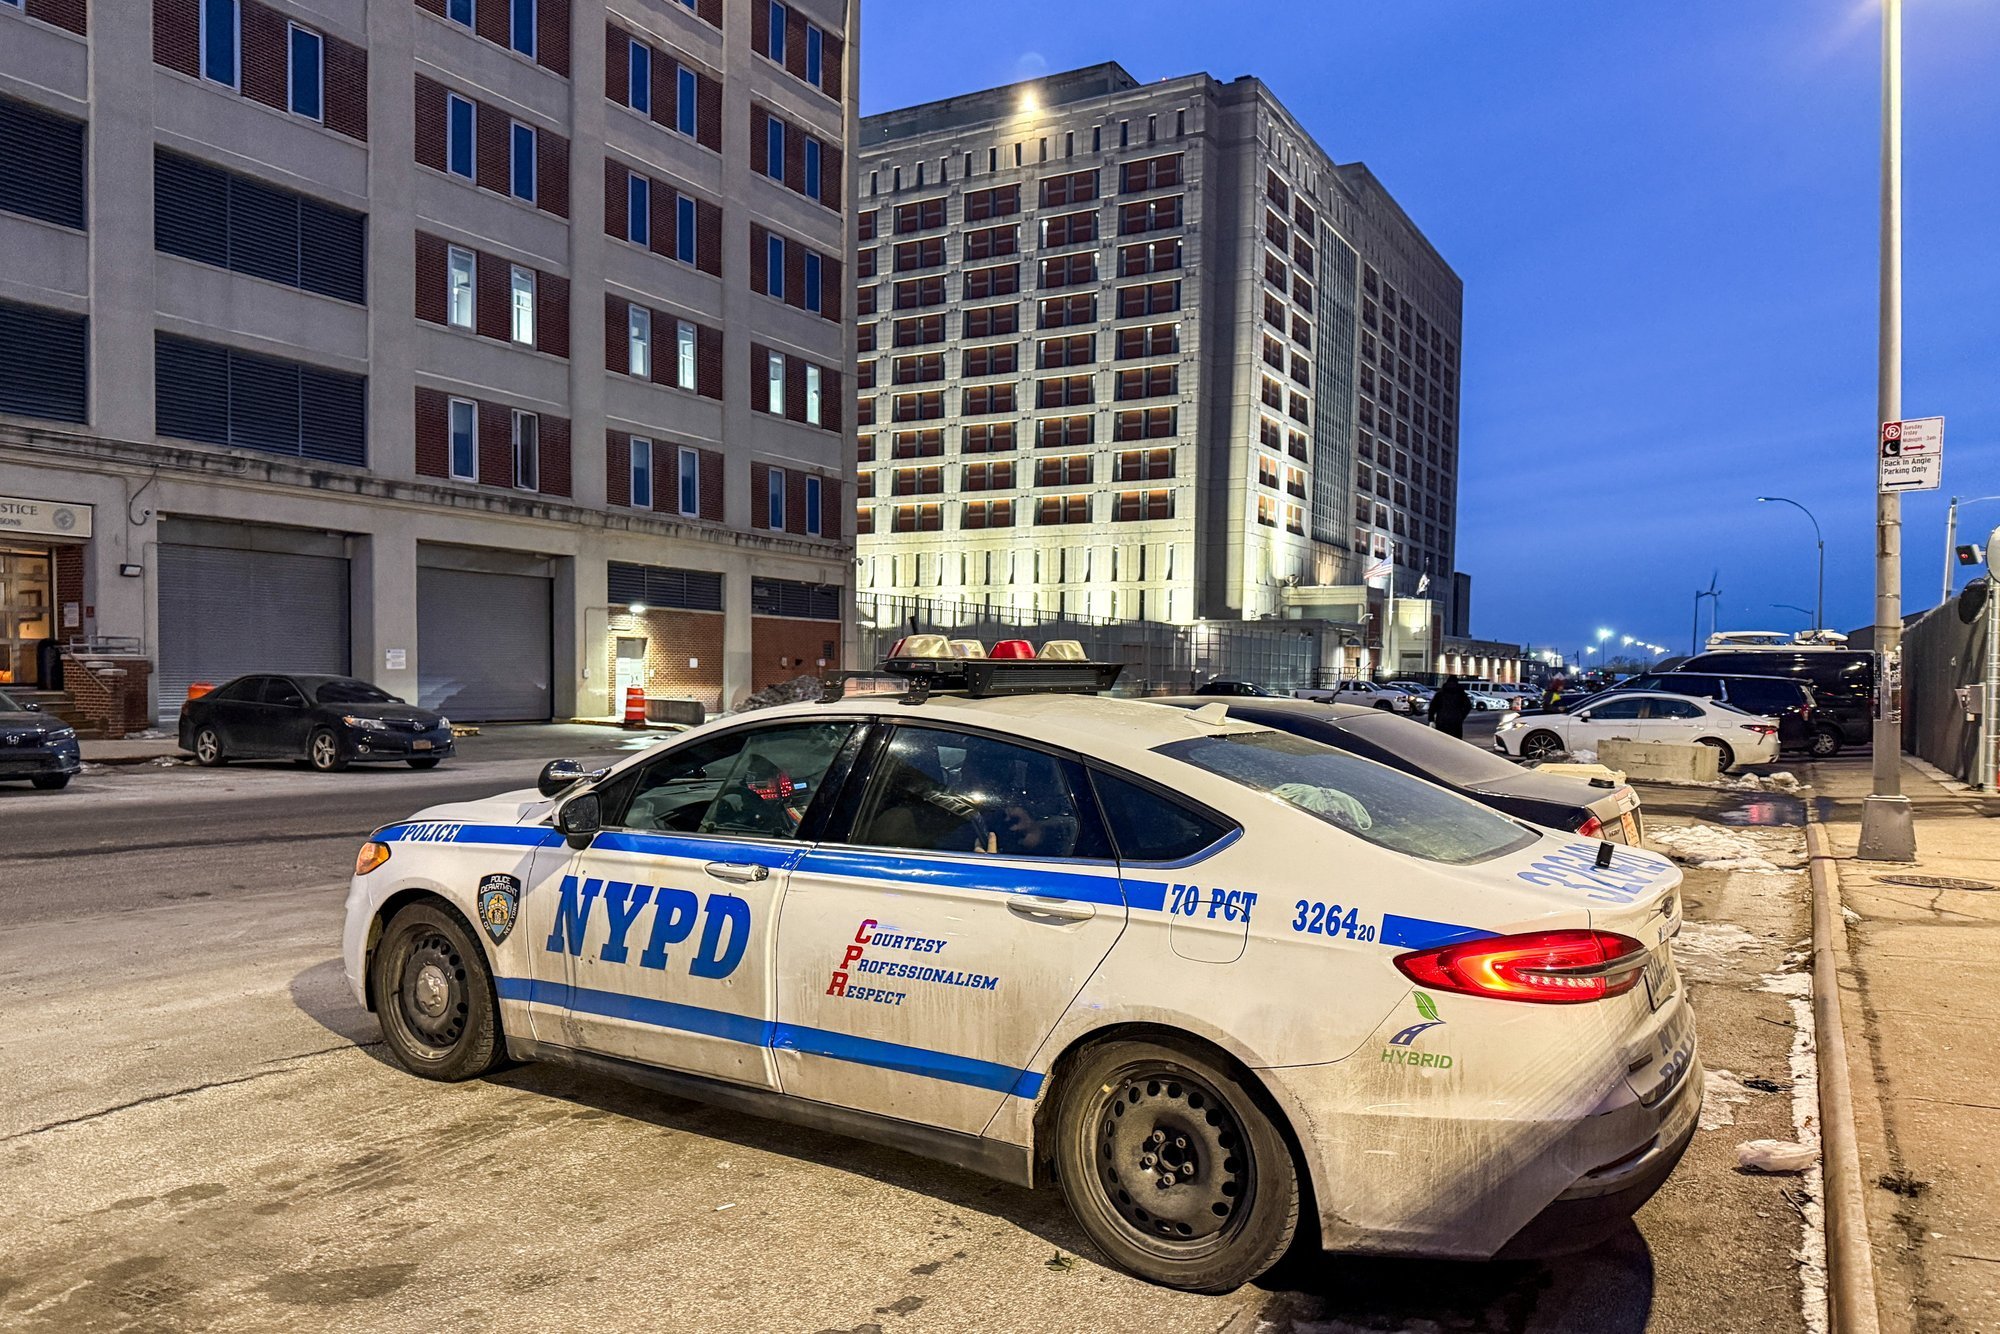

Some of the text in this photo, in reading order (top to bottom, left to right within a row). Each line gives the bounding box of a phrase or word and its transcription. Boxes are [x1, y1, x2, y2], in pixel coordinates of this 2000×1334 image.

[1884, 459, 1900, 467] Back
[1884, 465, 1928, 475] Parking Only
[400, 823, 461, 842] POLICE
[480, 883, 518, 897] DEPARTMENT
[490, 875, 512, 885] POLICE
[510, 902, 518, 919] YORK
[1170, 884, 1258, 923] 70 PCT
[478, 901, 492, 930] CITY OF
[546, 875, 751, 979] NYPD
[854, 918, 948, 954] COURTESY
[840, 944, 999, 991] PROFESSIONALISM
[826, 971, 907, 1006] RESPECT
[1381, 1048, 1454, 1069] HYBRID
